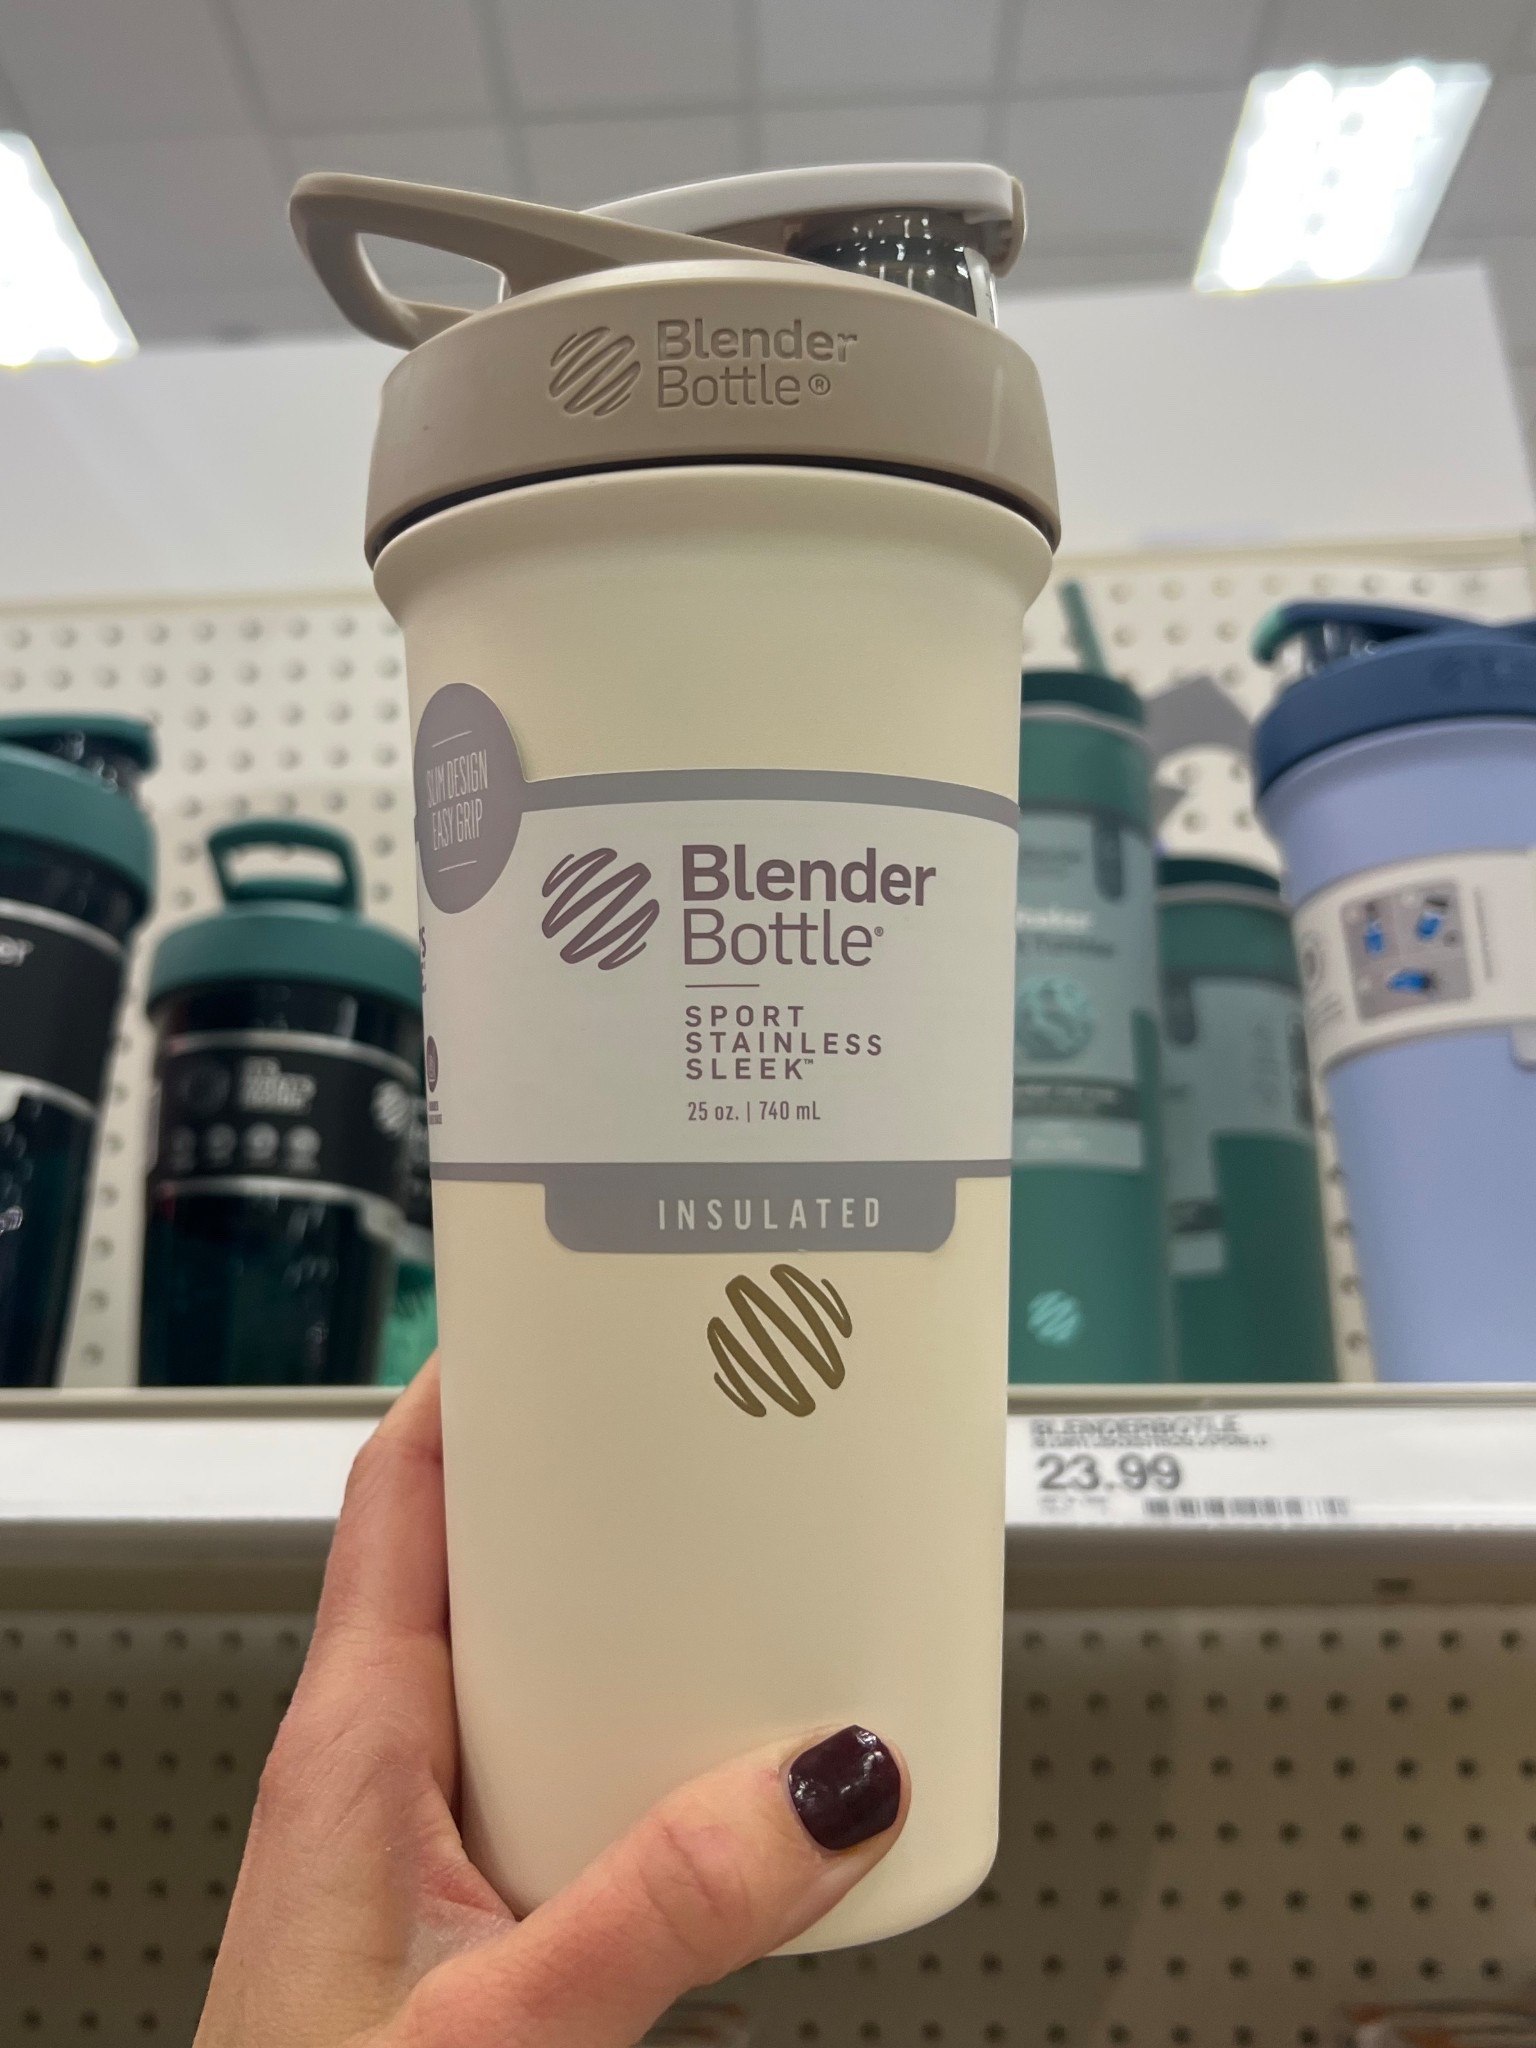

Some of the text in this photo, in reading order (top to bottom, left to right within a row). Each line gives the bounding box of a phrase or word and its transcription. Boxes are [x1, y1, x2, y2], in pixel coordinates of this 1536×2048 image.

[657, 318, 858, 363] Blender
[426, 749, 489, 809] SLIM DESIGN
[432, 798, 483, 851] EASY GRIP
[681, 843, 937, 907] Blender
[684, 1004, 805, 1029] SPORT
[684, 1031, 883, 1057] STAINLESS
[687, 1101, 709, 1122] 25
[714, 1105, 740, 1121] oz.
[759, 1100, 790, 1121] 740
[796, 1100, 822, 1121] mL
[657, 1197, 881, 1231] INSULATED
[1037, 1452, 1182, 1492] 23.99
